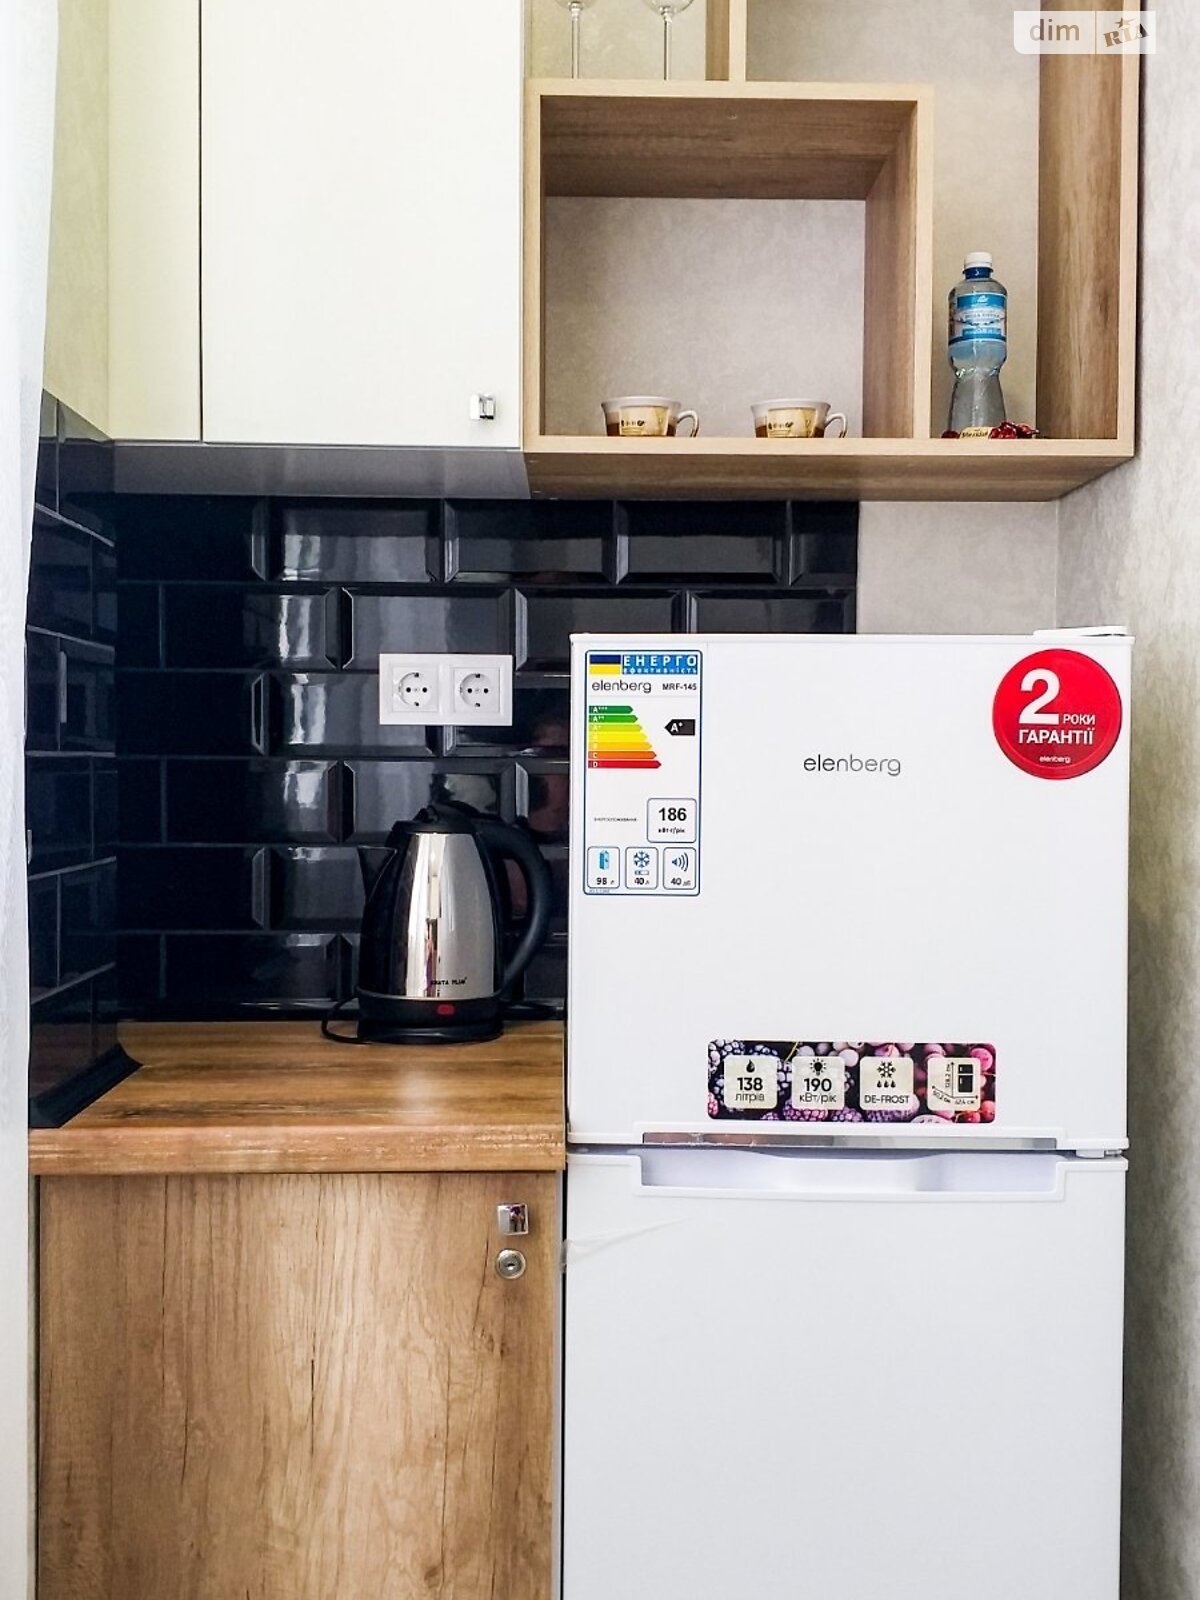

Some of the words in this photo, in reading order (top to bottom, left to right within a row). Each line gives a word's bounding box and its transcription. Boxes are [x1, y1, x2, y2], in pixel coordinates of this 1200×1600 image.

[623, 655, 698, 667] ЕНЕРГО
[591, 680, 652, 694] elenberg
[662, 682, 697, 691] MRF-145
[1018, 667, 1061, 725] 2
[1062, 713, 1096, 725] РОКИ
[1018, 727, 1095, 745] ГАРАНТІЇ
[803, 753, 901, 777] elenberg
[1039, 755, 1071, 764] elenberg
[658, 807, 687, 822] 186
[670, 877, 682, 886] 40
[736, 1077, 764, 1091] 138
[803, 1078, 832, 1092] 190
[735, 1092, 765, 1103] літрів
[799, 1092, 837, 1104] кВт/рік
[864, 1095, 910, 1104] DE-FROST
